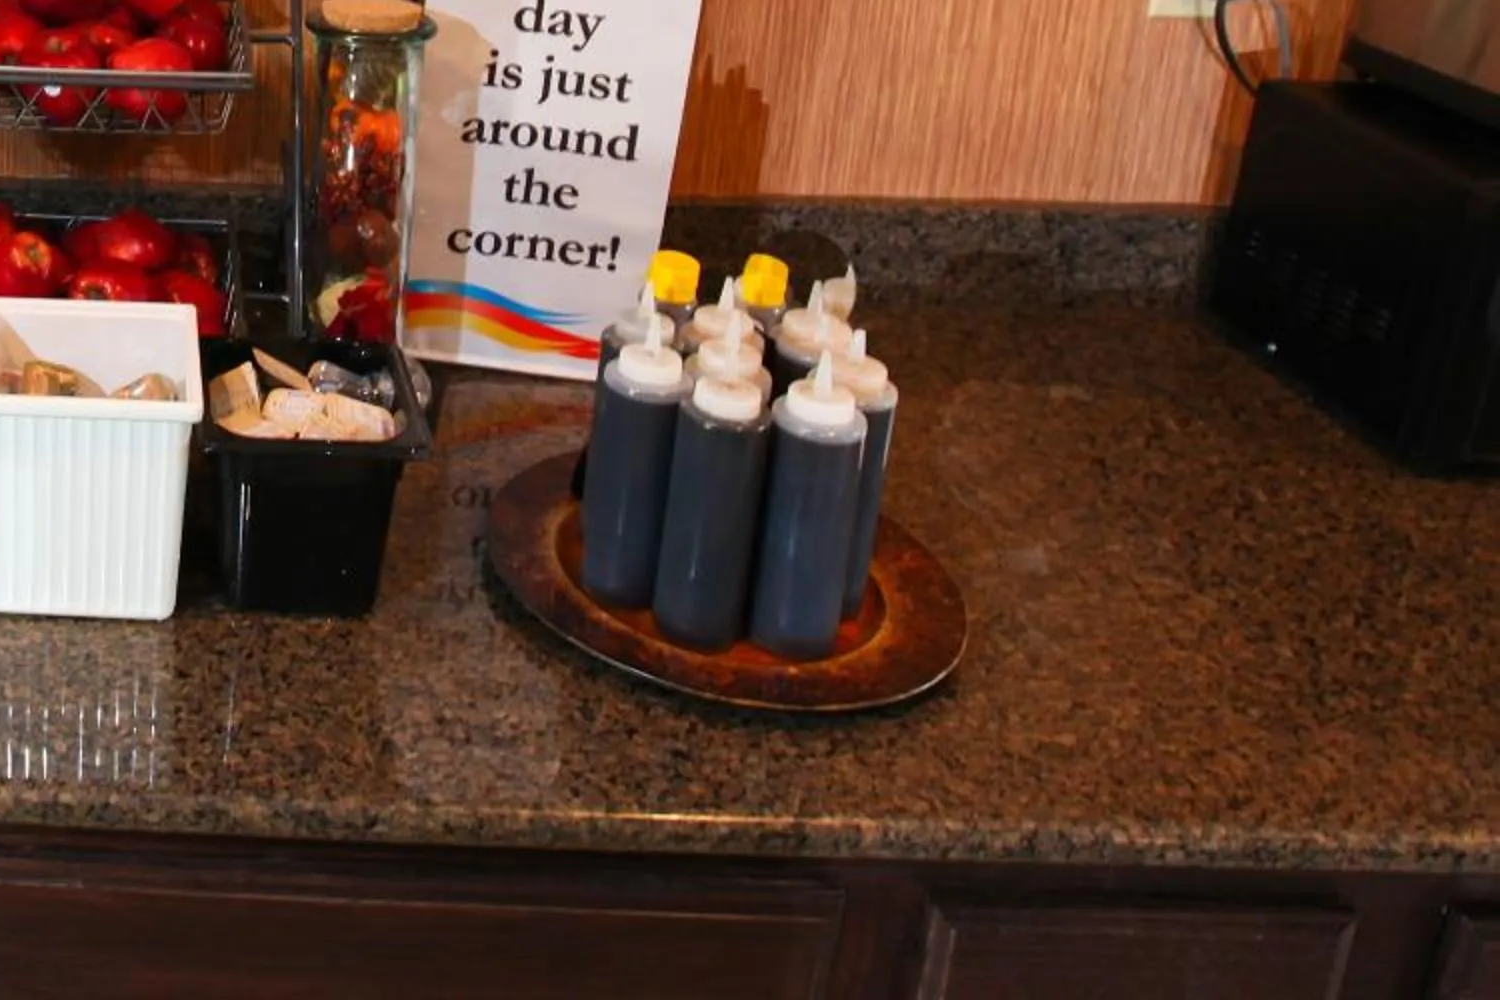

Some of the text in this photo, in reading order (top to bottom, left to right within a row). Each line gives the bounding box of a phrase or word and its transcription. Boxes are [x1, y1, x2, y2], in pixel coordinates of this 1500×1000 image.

[483, 48, 633, 105] is just
[460, 114, 639, 163] around
[503, 168, 580, 211] the
[446, 226, 622, 273] corner!
